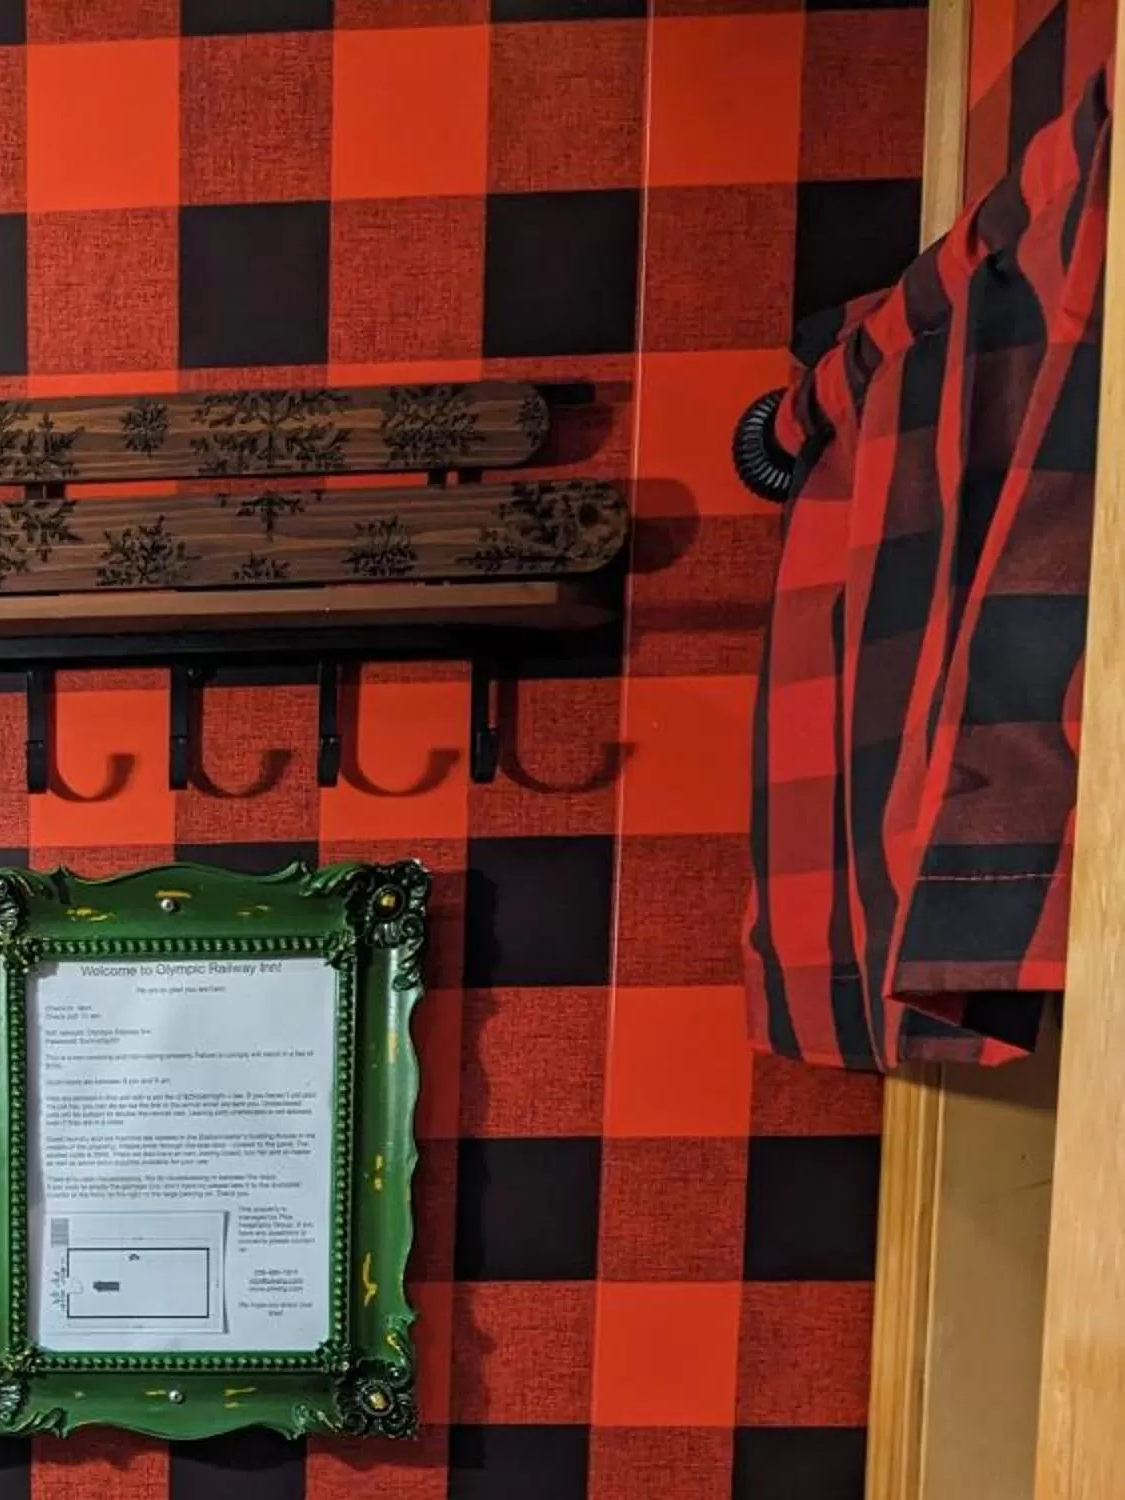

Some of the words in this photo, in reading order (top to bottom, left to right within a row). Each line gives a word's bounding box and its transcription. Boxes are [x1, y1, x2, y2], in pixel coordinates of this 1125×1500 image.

[79, 964, 137, 977] Welcome
[140, 964, 153, 976] to
[156, 963, 207, 977] Olympic
[208, 961, 257, 977] Railway
